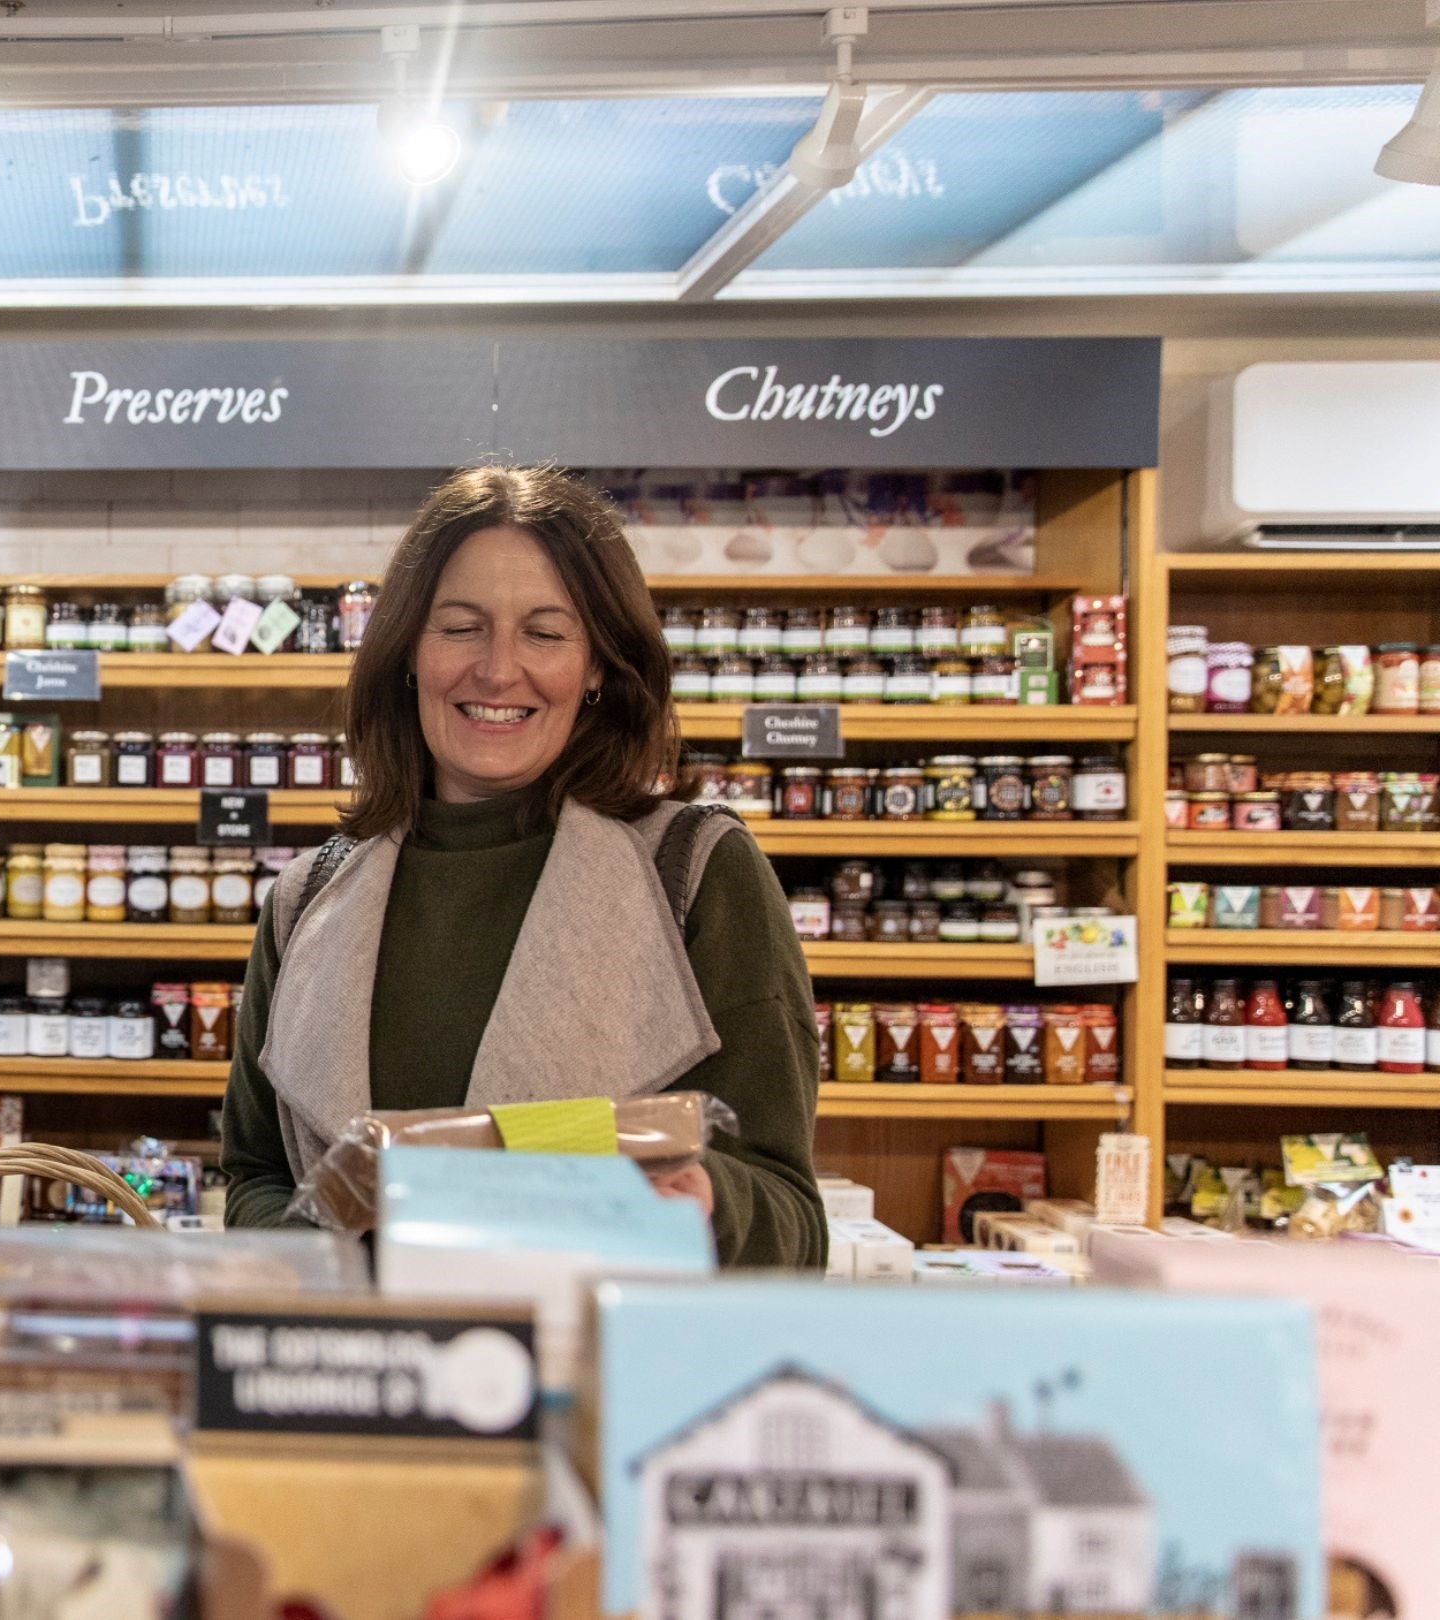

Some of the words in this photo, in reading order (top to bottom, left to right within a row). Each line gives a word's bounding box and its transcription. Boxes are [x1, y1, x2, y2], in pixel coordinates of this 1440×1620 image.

[62, 370, 289, 425] Preserves
[705, 365, 944, 437] Chutneys
[764, 715, 819, 729] Cheshire
[765, 731, 819, 748] Chutney
[220, 797, 246, 810] NEW
[216, 823, 251, 837] STORE
